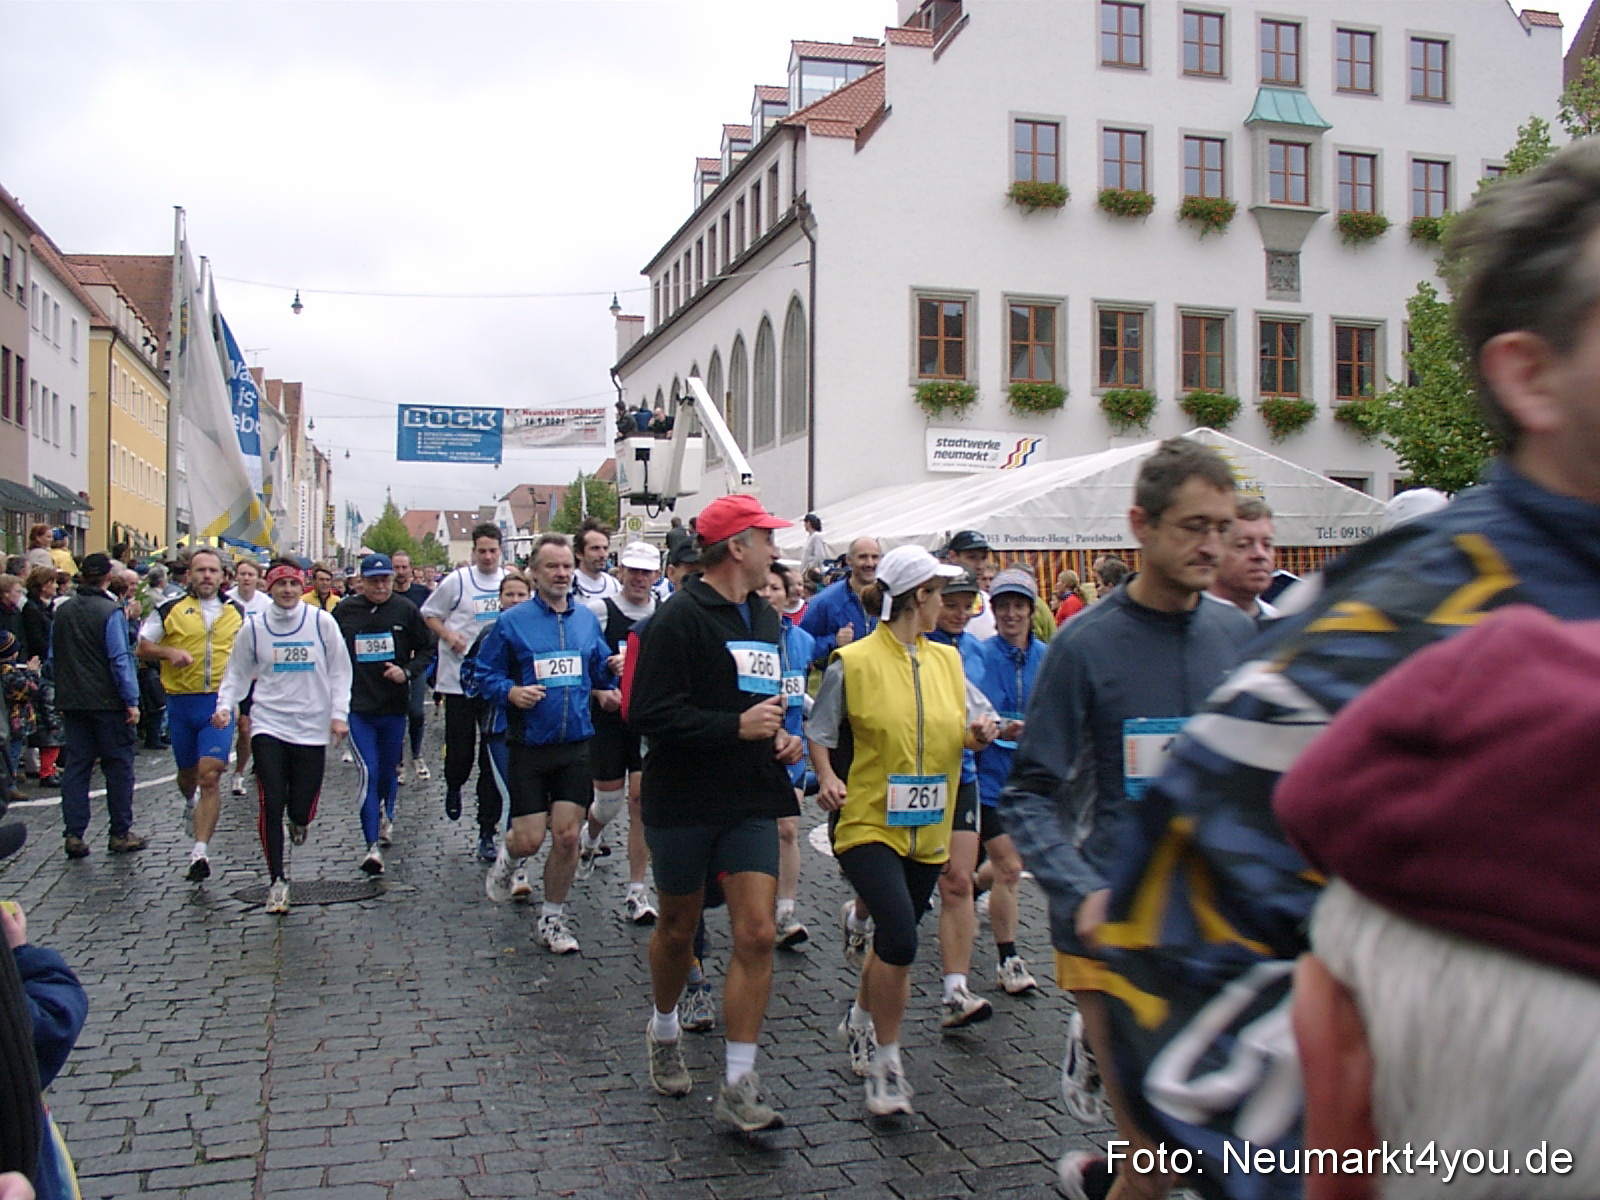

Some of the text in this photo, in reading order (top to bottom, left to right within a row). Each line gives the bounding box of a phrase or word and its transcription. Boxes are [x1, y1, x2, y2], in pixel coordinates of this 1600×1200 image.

[404, 407, 497, 431] BOCK
[935, 437, 1001, 451] stadtwerke
[933, 449, 988, 462] neumarkt
[366, 640, 387, 653] 394
[284, 648, 308, 662] 289
[549, 658, 573, 675] 267
[748, 652, 774, 676] 266
[782, 678, 800, 694] 68
[908, 785, 938, 808] 261
